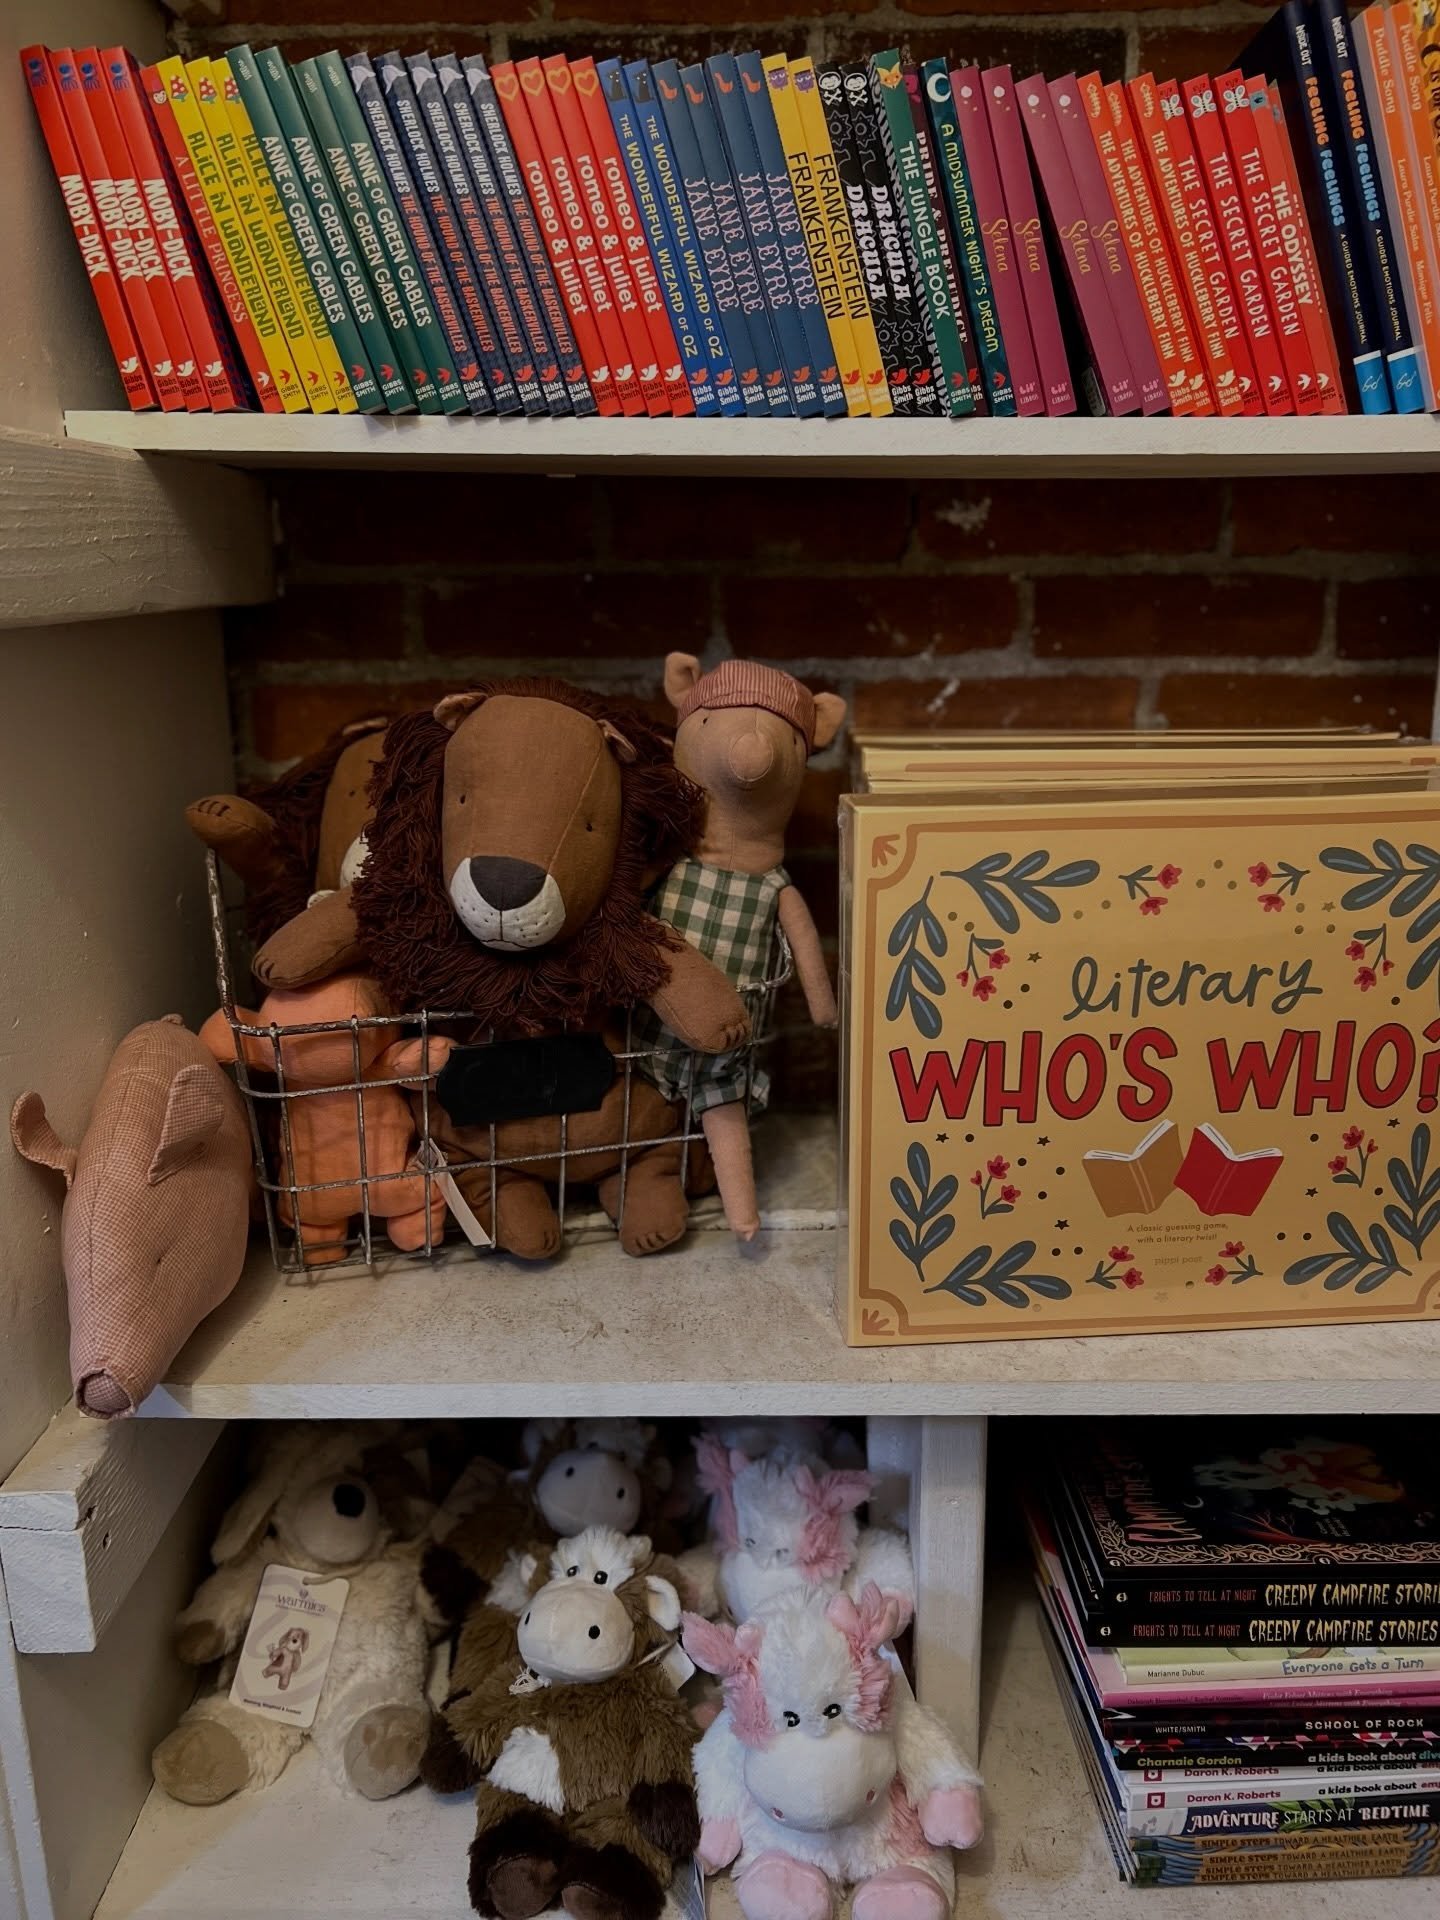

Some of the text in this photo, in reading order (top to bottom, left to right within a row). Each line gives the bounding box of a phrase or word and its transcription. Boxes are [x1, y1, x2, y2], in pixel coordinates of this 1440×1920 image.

[1373, 27, 1396, 114] Puddle Song
[60, 174, 110, 279] MOBY-DICK
[91, 179, 143, 282] MOBY-DICK
[114, 179, 165, 282] MOBY-DICK
[143, 179, 194, 282] MOBY-DICK
[176, 156, 248, 323] A LITTLE PRINCESS
[262, 136, 345, 323] ANNE OF GREEN GABLES
[291, 136, 374, 323] ANNE OF GREEN GABLES
[351, 142, 432, 327] ANNE OF GREEN GABLES
[367, 101, 467, 352] SHERLOCK HOLMES THE HOUND OF THE BASKERVILLES
[427, 102, 522, 353] SHERLOCK HOLMES THE HOUND OF THE BASKERVILLES
[527, 161, 588, 315] romeo & juliet
[577, 155, 637, 312] romeo & juliet
[604, 157, 662, 312] romeo & juliet
[619, 114, 698, 358] THE WONDERFUL WIZARD OF OZ
[739, 172, 792, 309] JANE EYRE
[766, 172, 819, 309] JANE EYRE
[788, 152, 846, 319] FRANKENSTEIN
[813, 153, 869, 320] FRANKENSTEIN
[846, 184, 887, 300] DRACULA
[871, 184, 911, 300] DRACULA
[900, 140, 951, 320] THE JUNGLE BOOK
[941, 123, 999, 353] A MIDSUMMER NIGHT'S DREAM
[981, 218, 1009, 273] Selena
[1099, 131, 1176, 360] THE ADVENTURES OF HUCKLEBERRY FINN
[1209, 151, 1271, 338] THE SECRET GARDEN
[1241, 147, 1301, 337] THE SECRET GARDEN
[1271, 180, 1293, 221] THE
[1281, 223, 1313, 305] ODYSSEY
[1377, 235, 1387, 265] GUIDED
[1382, 265, 1396, 305] EMOTIONS
[1390, 306, 1402, 341] JOURNAL
[463, 381, 483, 392] Gibbs
[466, 388, 486, 400] Smith
[692, 385, 712, 397] Gibbs
[694, 393, 715, 405] Smith
[892, 386, 911, 397] Gibbs
[894, 393, 913, 405] Smith
[1063, 956, 1323, 1021] literary
[888, 1026, 1178, 1127] WHO'S
[1136, 1224, 1163, 1232] classic
[1165, 1223, 1200, 1233] guessing
[1137, 1235, 1154, 1244] with
[1164, 1234, 1194, 1244] literary
[1133, 1624, 1241, 1637] FRIGHTS TO TELL AT NIGHT
[1249, 1618, 1439, 1642] CREEPY CAMPFIRE STORIES
[1265, 1583, 1390, 1607] CREEPY CAMPFIRE
[1282, 1658, 1424, 1675] Everyone Gets a Turn
[1137, 1756, 1242, 1766] Charnaie Gordon
[1155, 1726, 1206, 1734] WHITE/SMITH
[1305, 1719, 1424, 1730] SCHOOL OF ROCK
[1318, 1753, 1345, 1762] kids
[1347, 1752, 1377, 1761] book
[1380, 1752, 1417, 1760] about
[1187, 1791, 1280, 1803] Daron K. Roberts
[1187, 1804, 1430, 1833] ADVENTURE STARTS AT BEDTIME
[1274, 1836, 1308, 1844] TOWARD
[1323, 1834, 1366, 1843] HEALTHIER
[1371, 1833, 1398, 1841] EARTH
[1328, 1786, 1351, 1794] kids
[1354, 1784, 1384, 1793] book
[1387, 1782, 1417, 1791] about
